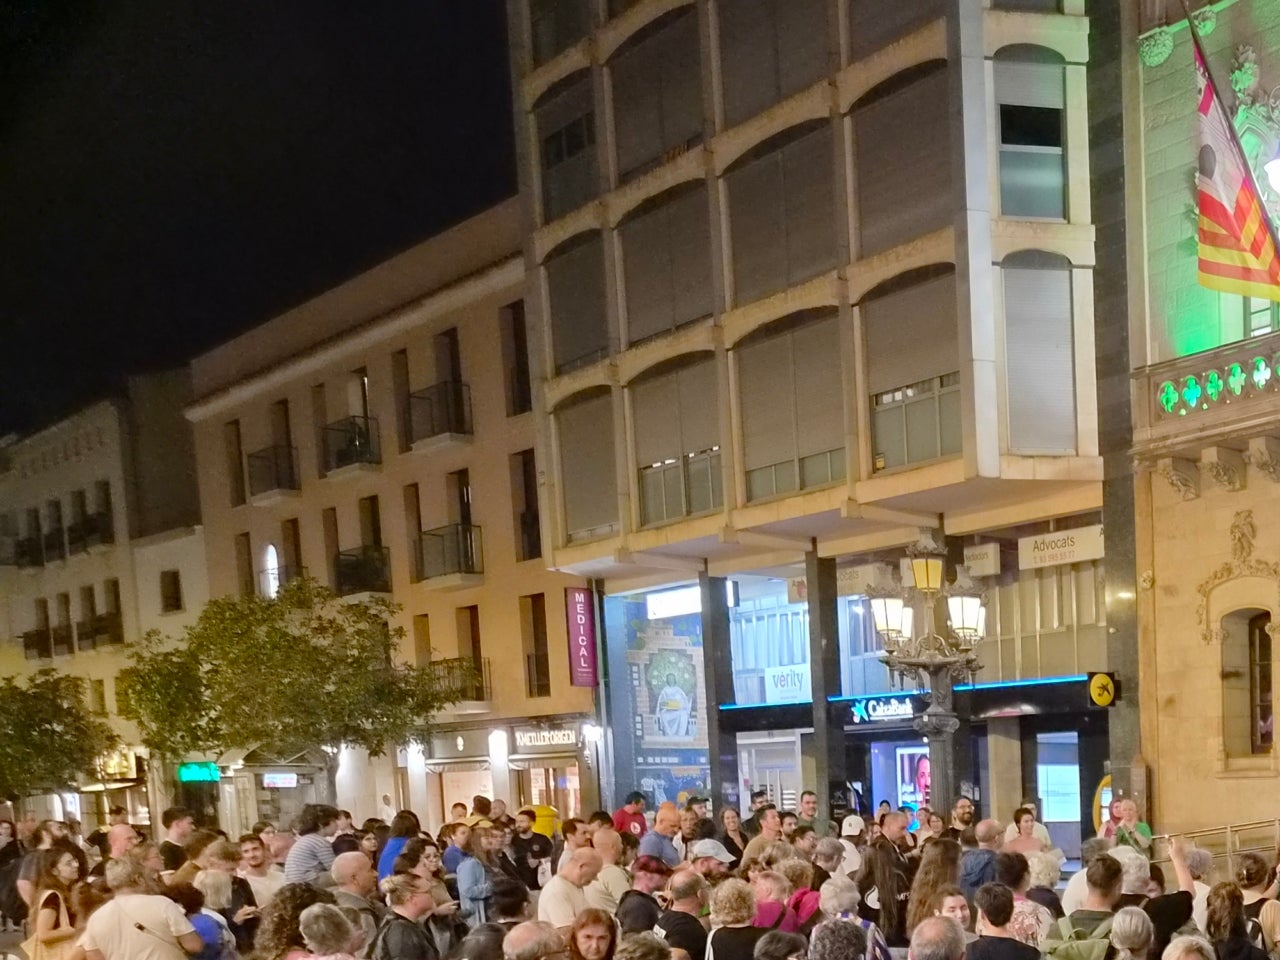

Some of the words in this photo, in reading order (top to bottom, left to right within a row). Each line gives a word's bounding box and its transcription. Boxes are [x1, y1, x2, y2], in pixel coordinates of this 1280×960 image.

[1032, 536, 1076, 552] Advocats
[575, 592, 588, 667] MEDICAL
[867, 697, 914, 717] CaixaBank
